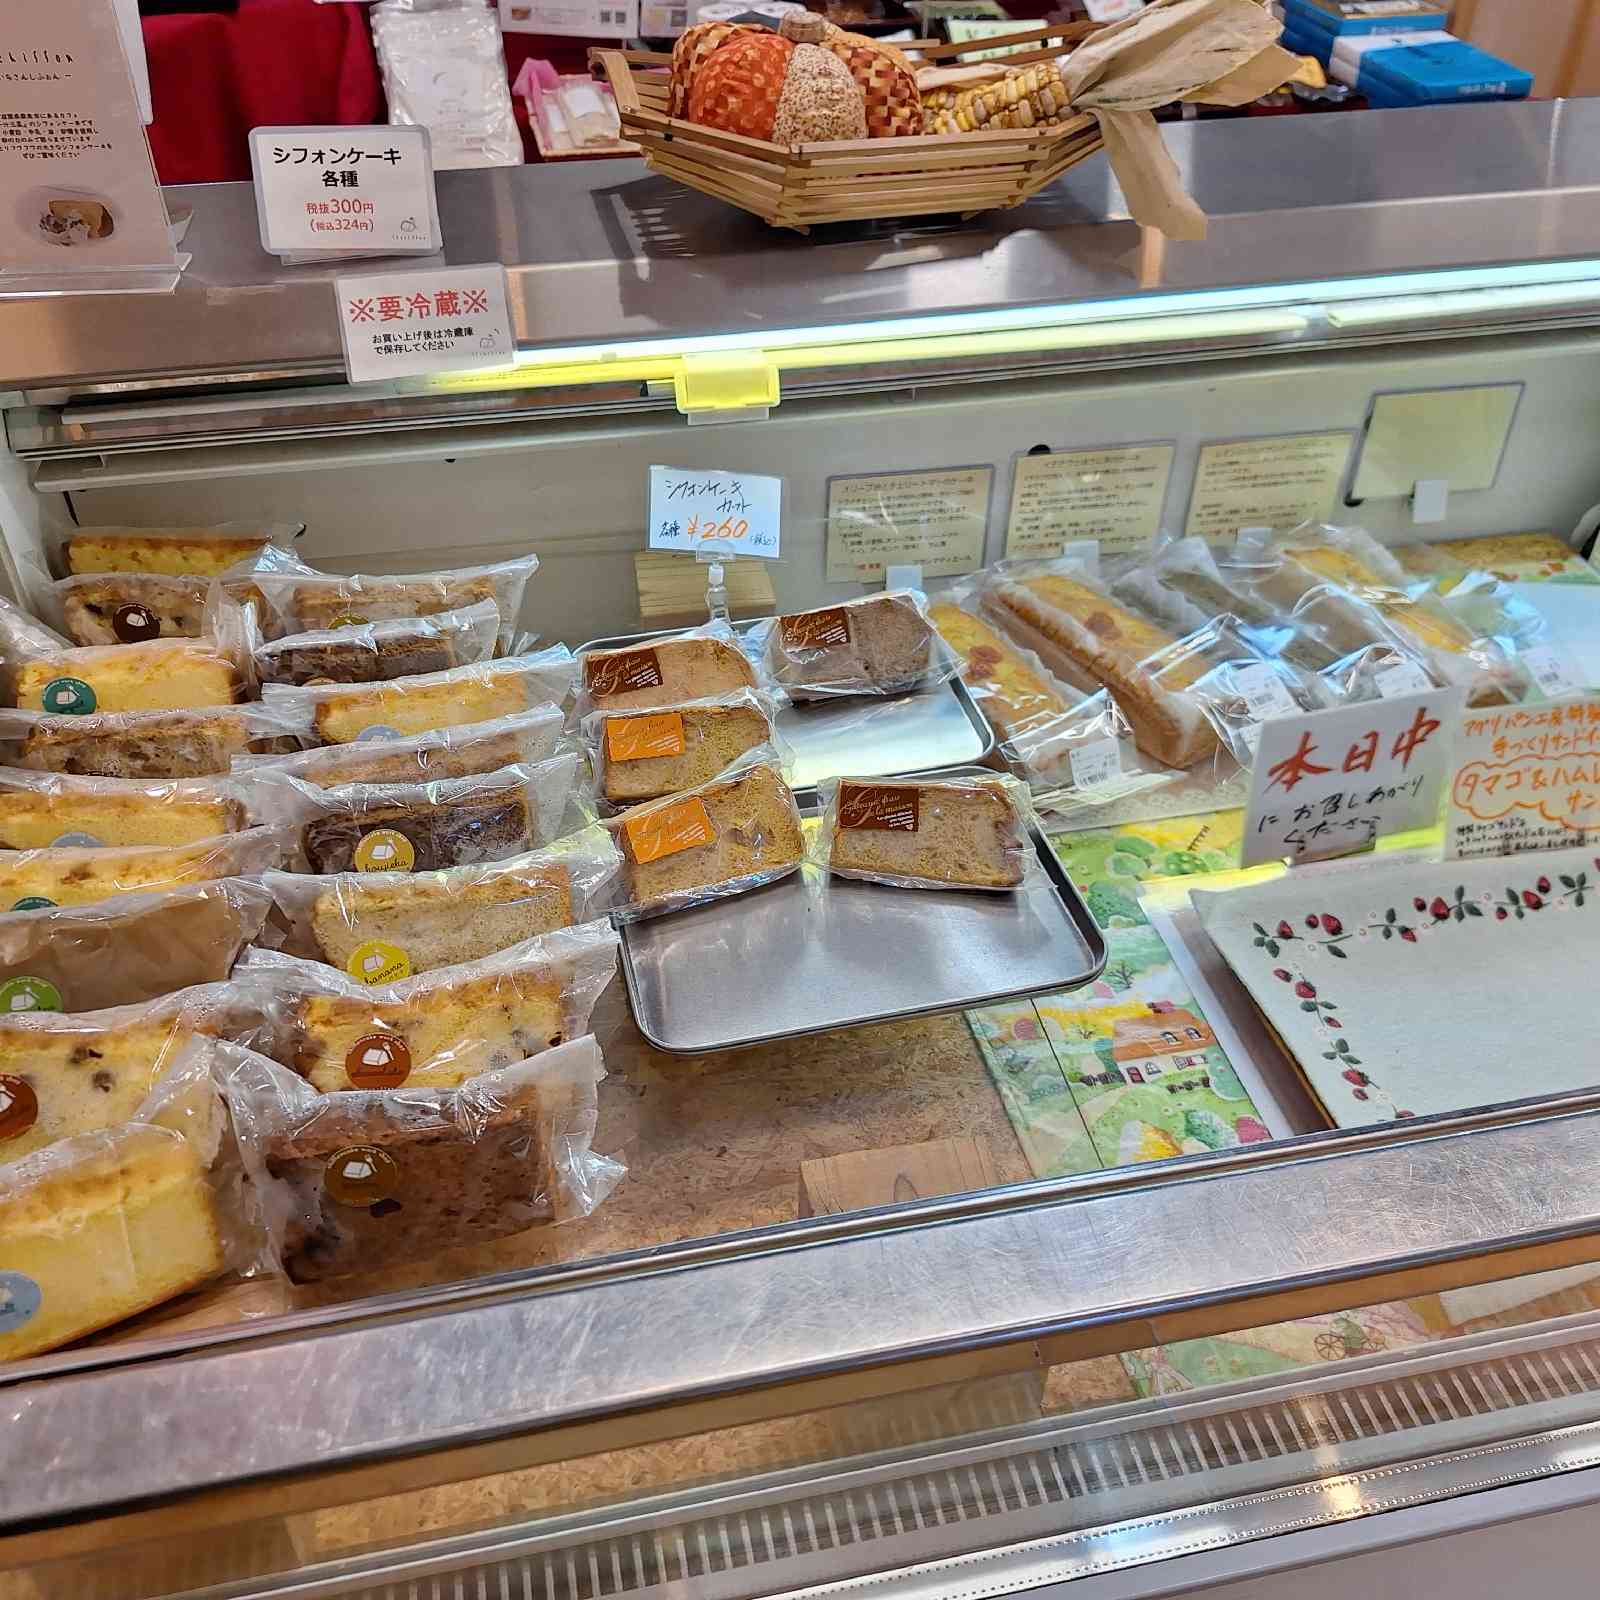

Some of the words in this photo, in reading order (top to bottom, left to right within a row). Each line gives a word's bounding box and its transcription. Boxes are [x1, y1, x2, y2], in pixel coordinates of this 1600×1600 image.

[272, 147, 402, 166] シフォンケーキ
[321, 170, 360, 188] 各種
[306, 198, 375, 215] 税抜300円
[371, 326, 475, 345] お買い上げ後は冷蔵庫
[374, 341, 455, 355] で保存してください
[1263, 706, 1441, 793] 本日中
